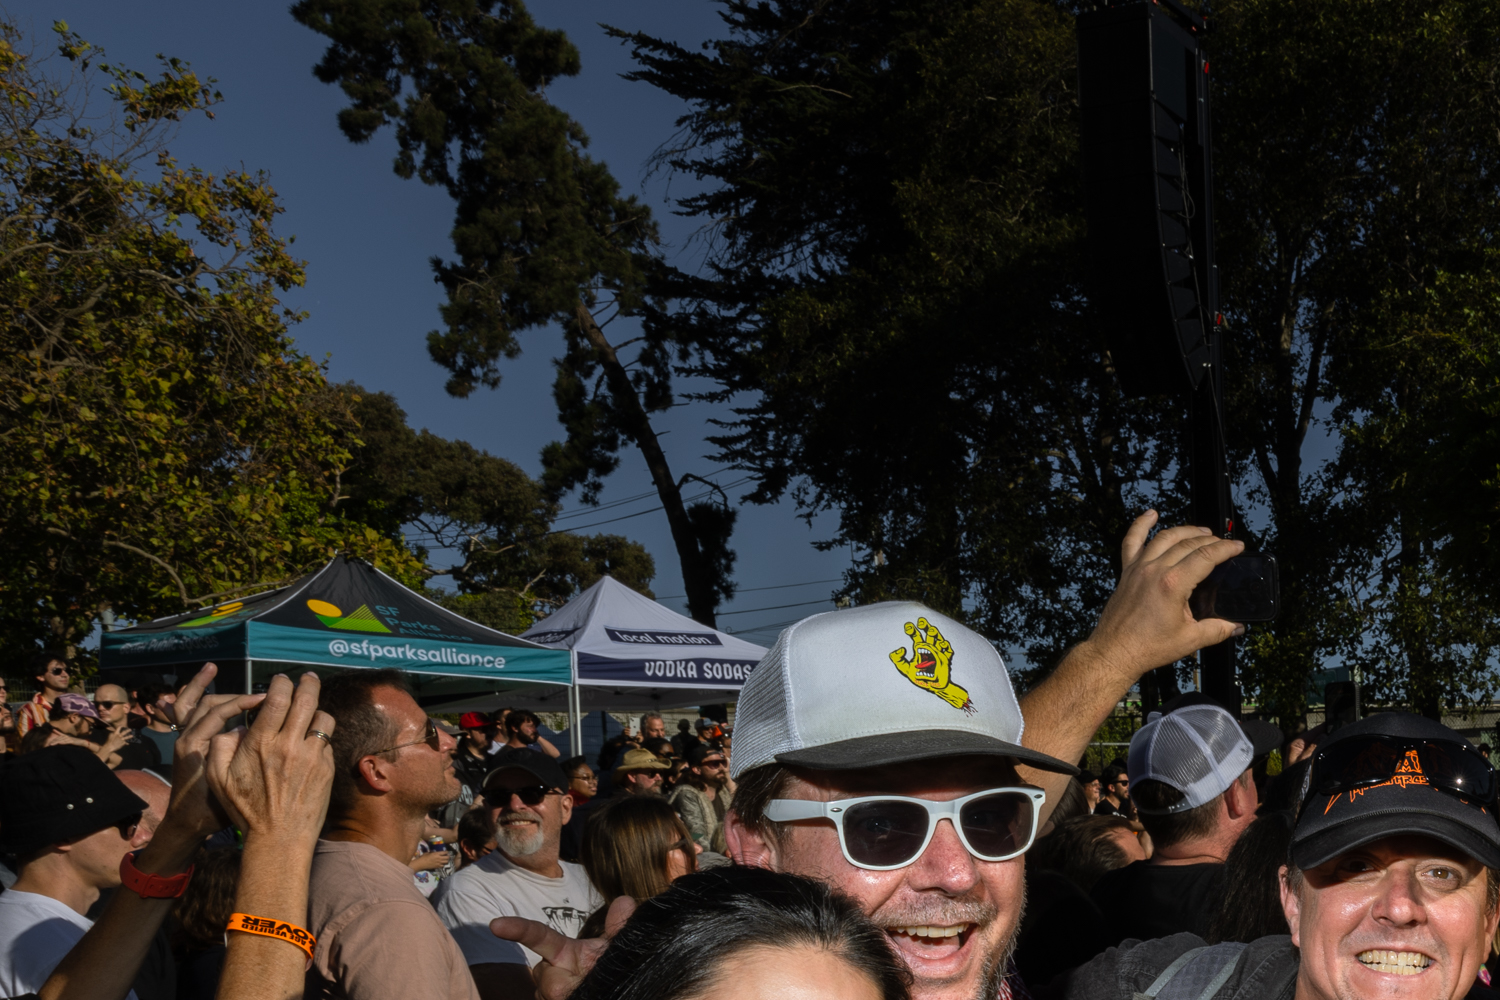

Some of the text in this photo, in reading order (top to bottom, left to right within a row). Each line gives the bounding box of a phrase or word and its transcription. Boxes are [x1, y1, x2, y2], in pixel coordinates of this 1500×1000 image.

[375, 605, 399, 616] SF
[384, 617, 441, 631] Parks
[399, 627, 473, 641] Alliance
[617, 631, 653, 643] local
[328, 638, 506, 668] @sfparksalliance
[645, 661, 752, 681] VODKA SODAS
[241, 923, 307, 946] AGE VERIFIED
[242, 915, 309, 940] OVER
